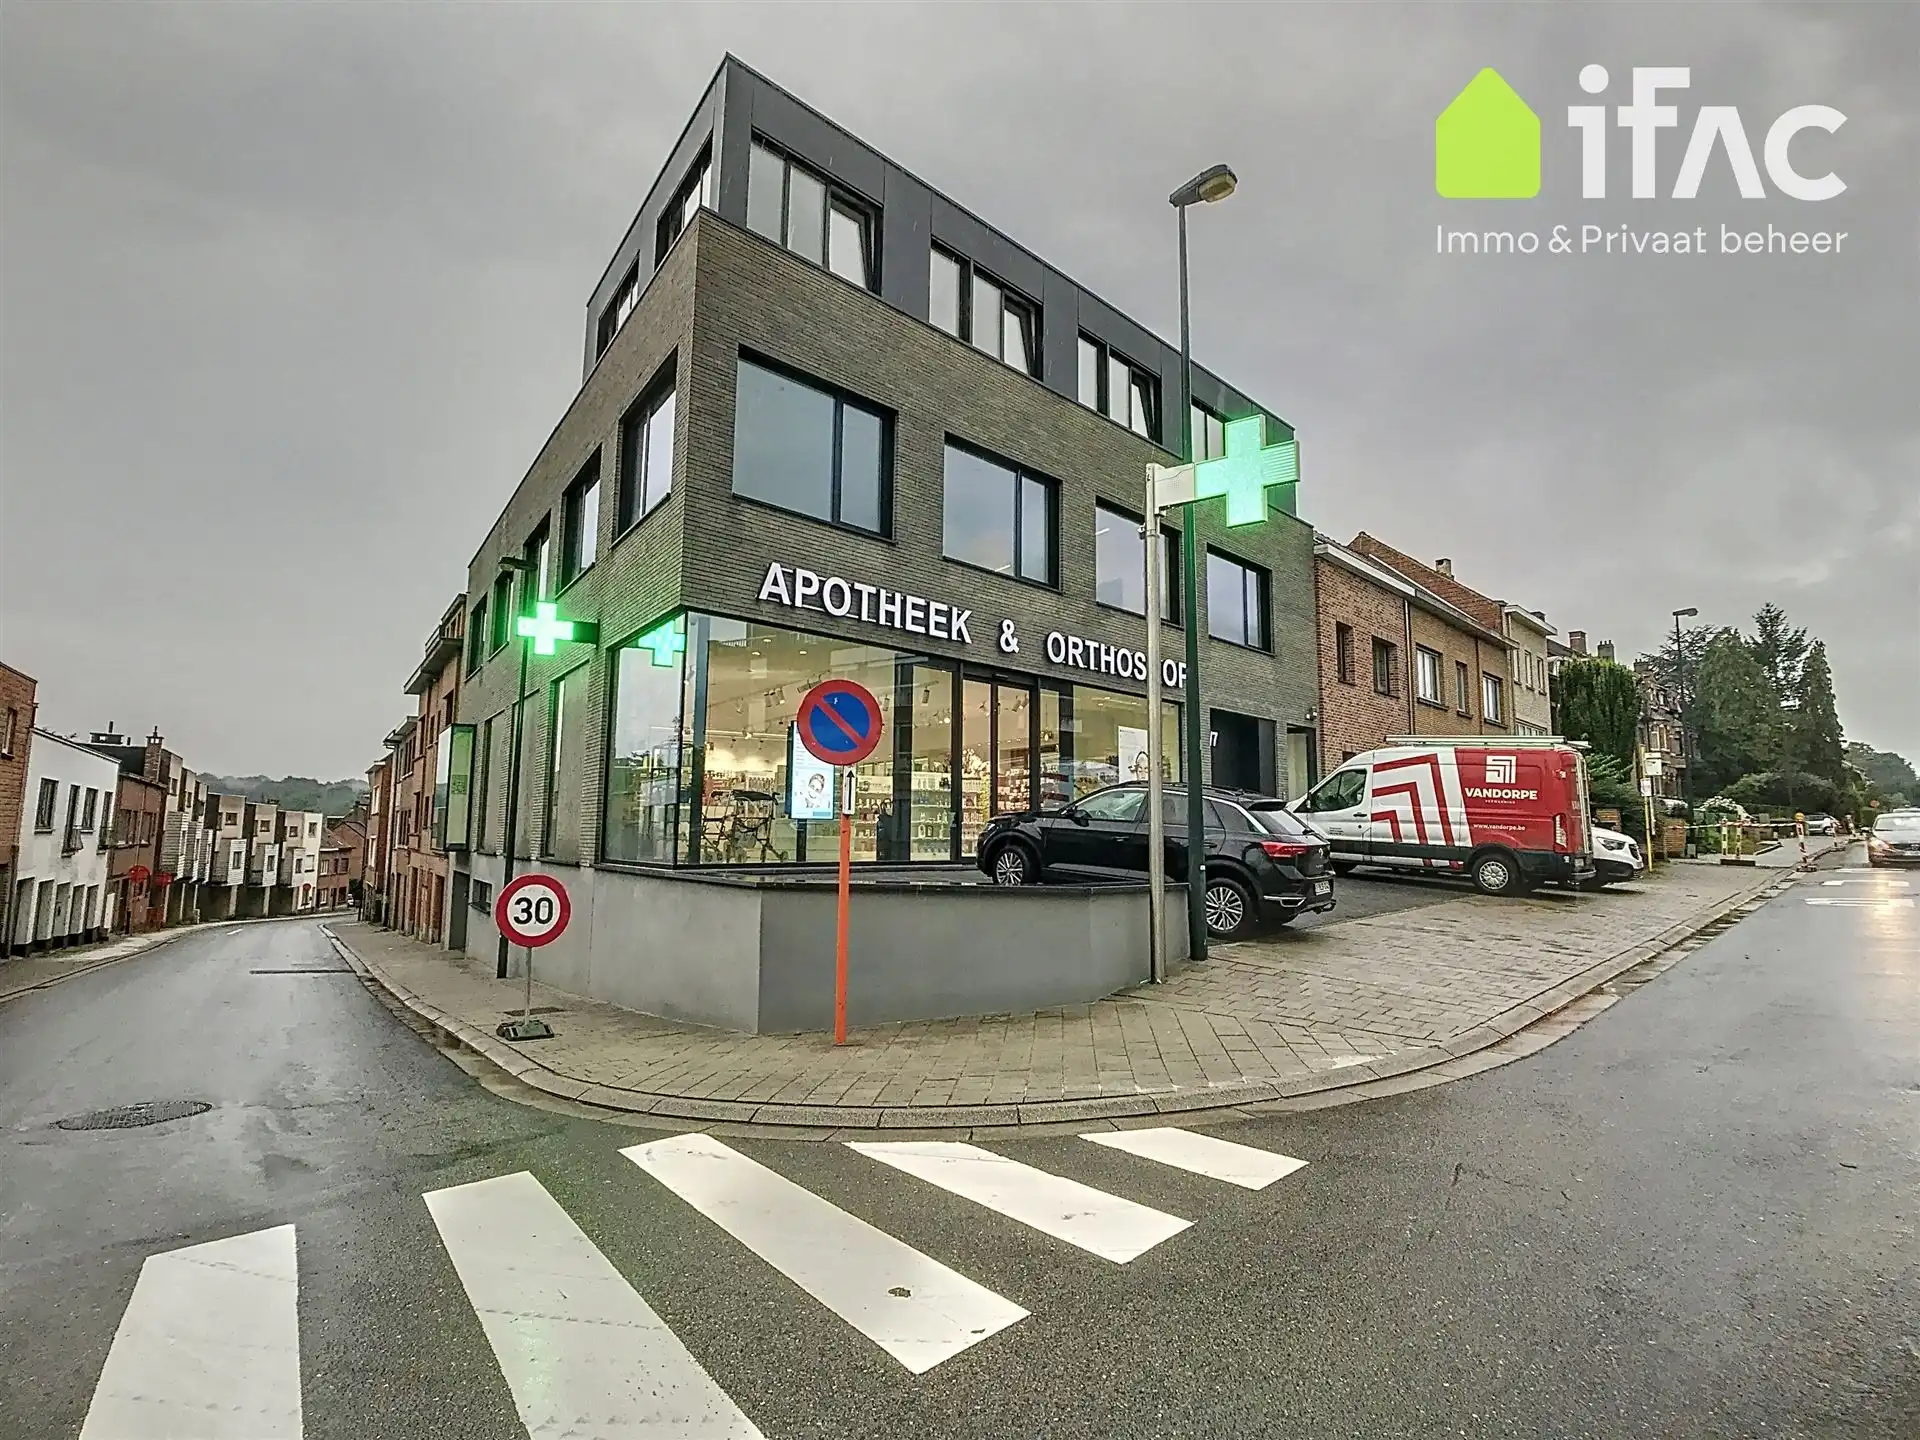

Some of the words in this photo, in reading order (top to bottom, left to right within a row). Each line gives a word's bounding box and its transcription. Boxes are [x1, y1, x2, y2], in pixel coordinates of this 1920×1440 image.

[758, 561, 973, 644] APOTHEEK
[1000, 619, 1020, 653] &
[1047, 631, 1187, 689] ORTHOSOP
[1464, 787, 1538, 800] VANDORPE
[1473, 823, 1526, 831] www.vandorpe.be
[513, 897, 554, 925] 30
